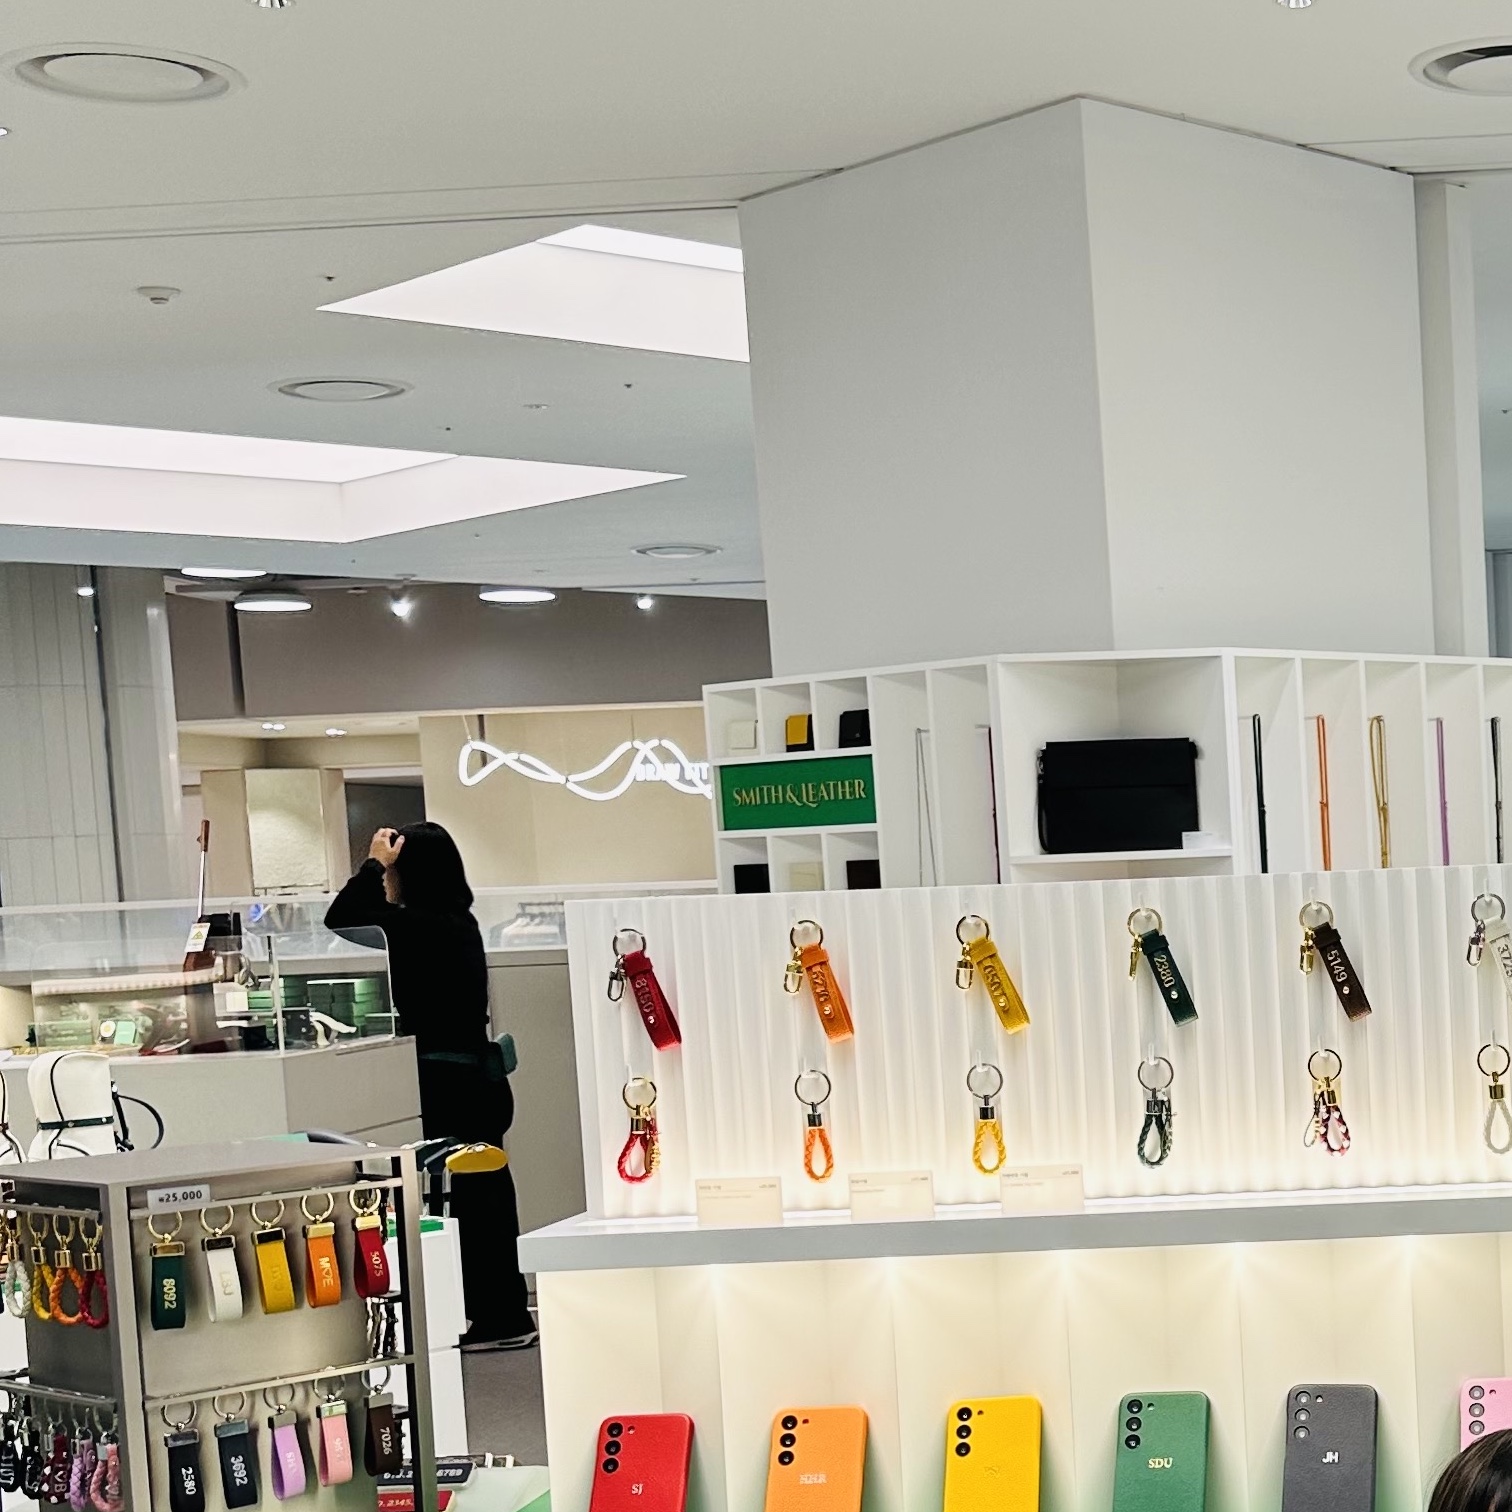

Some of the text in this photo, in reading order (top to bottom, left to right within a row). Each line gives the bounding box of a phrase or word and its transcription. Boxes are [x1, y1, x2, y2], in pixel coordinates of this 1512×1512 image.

[733, 779, 866, 808] SMITH & LEATHER
[1153, 954, 1175, 988] 2380
[1326, 950, 1348, 982] 5149
[380, 1426, 393, 1455] 7026
[230, 1455, 248, 1487] 3692
[1148, 1457, 1173, 1469] SDU
[1321, 1451, 1339, 1463] JH
[181, 1466, 197, 1496] 2580
